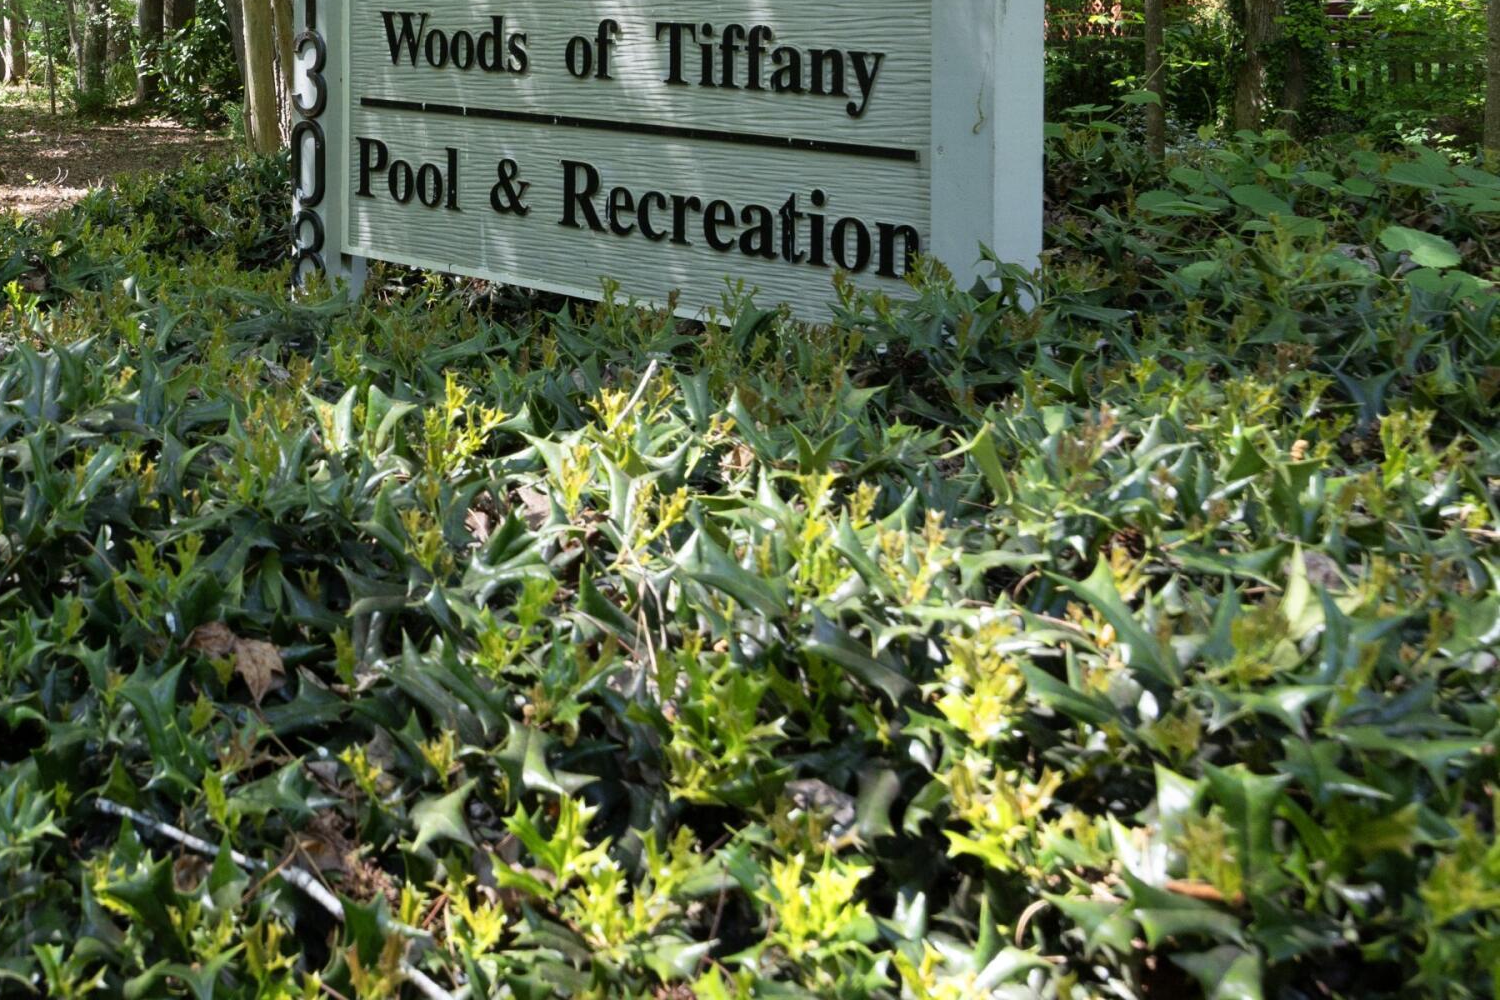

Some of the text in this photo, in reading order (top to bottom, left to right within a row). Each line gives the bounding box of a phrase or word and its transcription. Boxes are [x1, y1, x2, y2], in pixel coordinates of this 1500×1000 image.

[380, 10, 886, 118] Woods of Tiffany
[354, 136, 921, 279] Pool & Recreation
